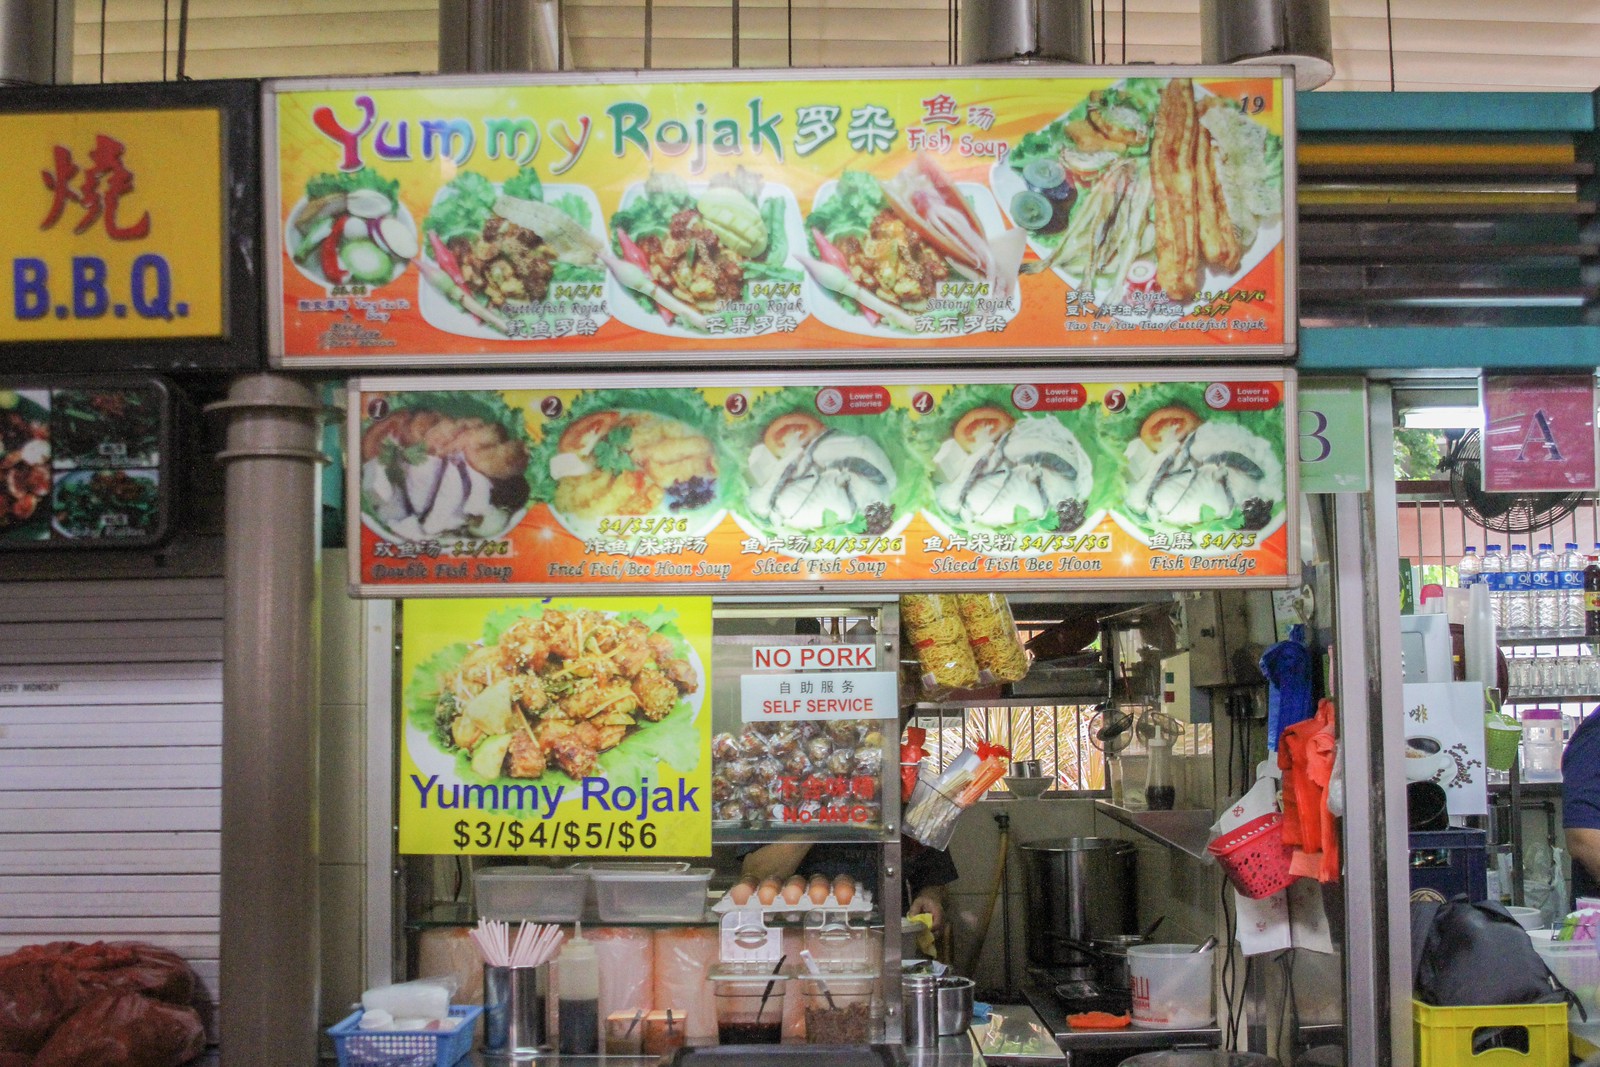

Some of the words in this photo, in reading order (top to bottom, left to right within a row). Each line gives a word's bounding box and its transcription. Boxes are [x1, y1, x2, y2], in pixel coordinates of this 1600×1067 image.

[921, 93, 996, 130] 鱼汤
[1239, 96, 1265, 115] 19
[312, 96, 592, 175] Yummy
[605, 97, 783, 176] Rojak
[793, 103, 898, 156] 罗杂
[907, 127, 951, 153] Fish
[959, 134, 1009, 164] Soup
[13, 253, 190, 322] B.B.Q.
[940, 282, 990, 299] $4/5/6
[571, 300, 611, 319] Rojak
[716, 299, 760, 316] Mango
[767, 298, 806, 316] Rojak
[926, 298, 971, 315] Sotong
[977, 296, 1016, 315] Rojak
[706, 315, 799, 335] 芒果罗杂
[849, 393, 874, 401] Lower
[850, 401, 883, 409] calories
[1045, 396, 1078, 404] calories
[1514, 409, 1567, 462] A
[598, 518, 688, 535] $4/$5/$6
[740, 535, 810, 555] 鱼片汤
[812, 537, 903, 555] $4/$5/$6
[922, 534, 1017, 553] 鱼片米粉
[1019, 535, 1110, 552] $4/$5/$6
[1200, 533, 1257, 550] $4/$5
[372, 562, 428, 580] Double
[434, 561, 468, 577] Fish
[473, 563, 513, 583] Soup
[547, 560, 585, 577] Fried
[654, 562, 693, 576] Hoon
[696, 561, 732, 581] Soup
[752, 557, 802, 575] Sliced
[806, 557, 842, 574] Fish
[846, 558, 887, 578] Soup
[930, 556, 979, 574] Sliced
[984, 555, 1019, 571] Fish
[1025, 556, 1054, 571] Bee
[1058, 557, 1102, 571] Hoon
[1150, 554, 1184, 570] Fish
[1190, 553, 1256, 575] Porridge
[1533, 572, 1548, 583] OK
[1564, 573, 1579, 583] OK
[755, 649, 791, 668] NO
[800, 647, 872, 667] PORK
[780, 680, 855, 694] 自助服务
[763, 700, 801, 714] SELF
[806, 698, 873, 713] SERVICE
[410, 774, 565, 819] Yummy
[581, 777, 699, 820] Rojak
[453, 820, 657, 851] $3/$4/$5/$6
